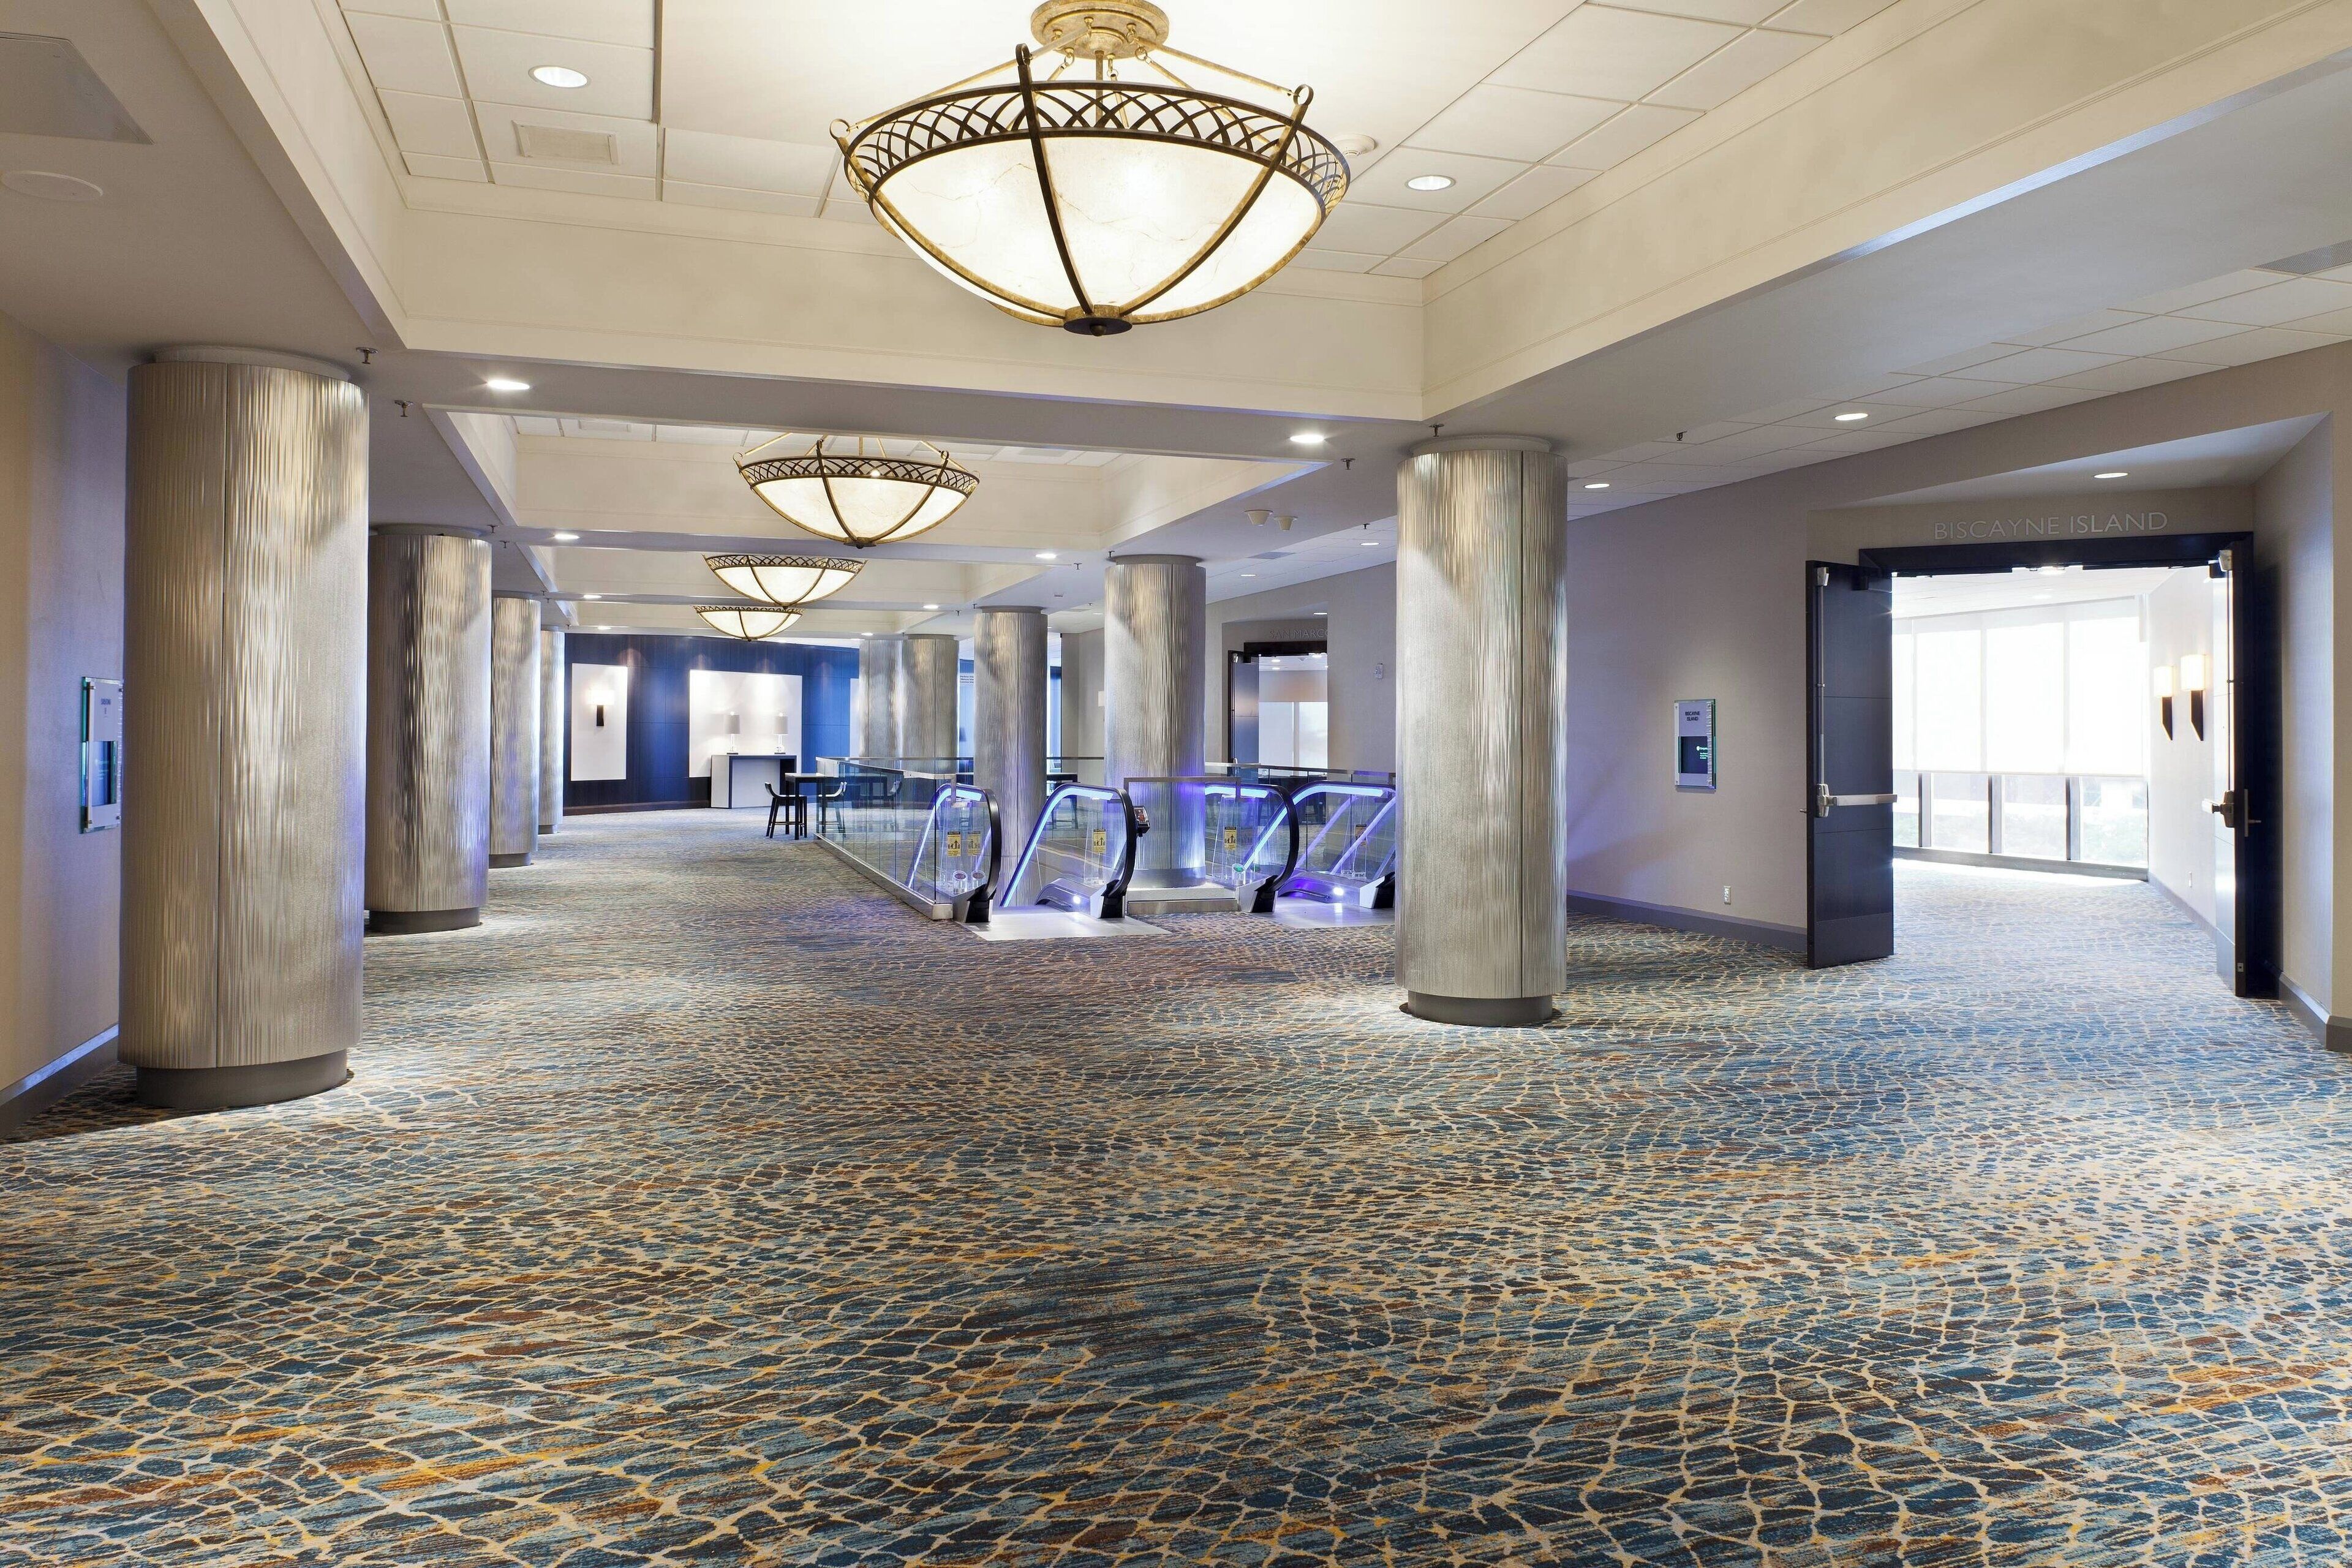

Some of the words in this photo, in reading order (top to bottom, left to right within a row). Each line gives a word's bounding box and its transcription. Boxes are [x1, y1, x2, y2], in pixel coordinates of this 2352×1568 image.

[1934, 516, 2059, 540] BISCAYNE
[2070, 511, 2168, 533] ISLAND
[1270, 629, 1291, 638] SAN
